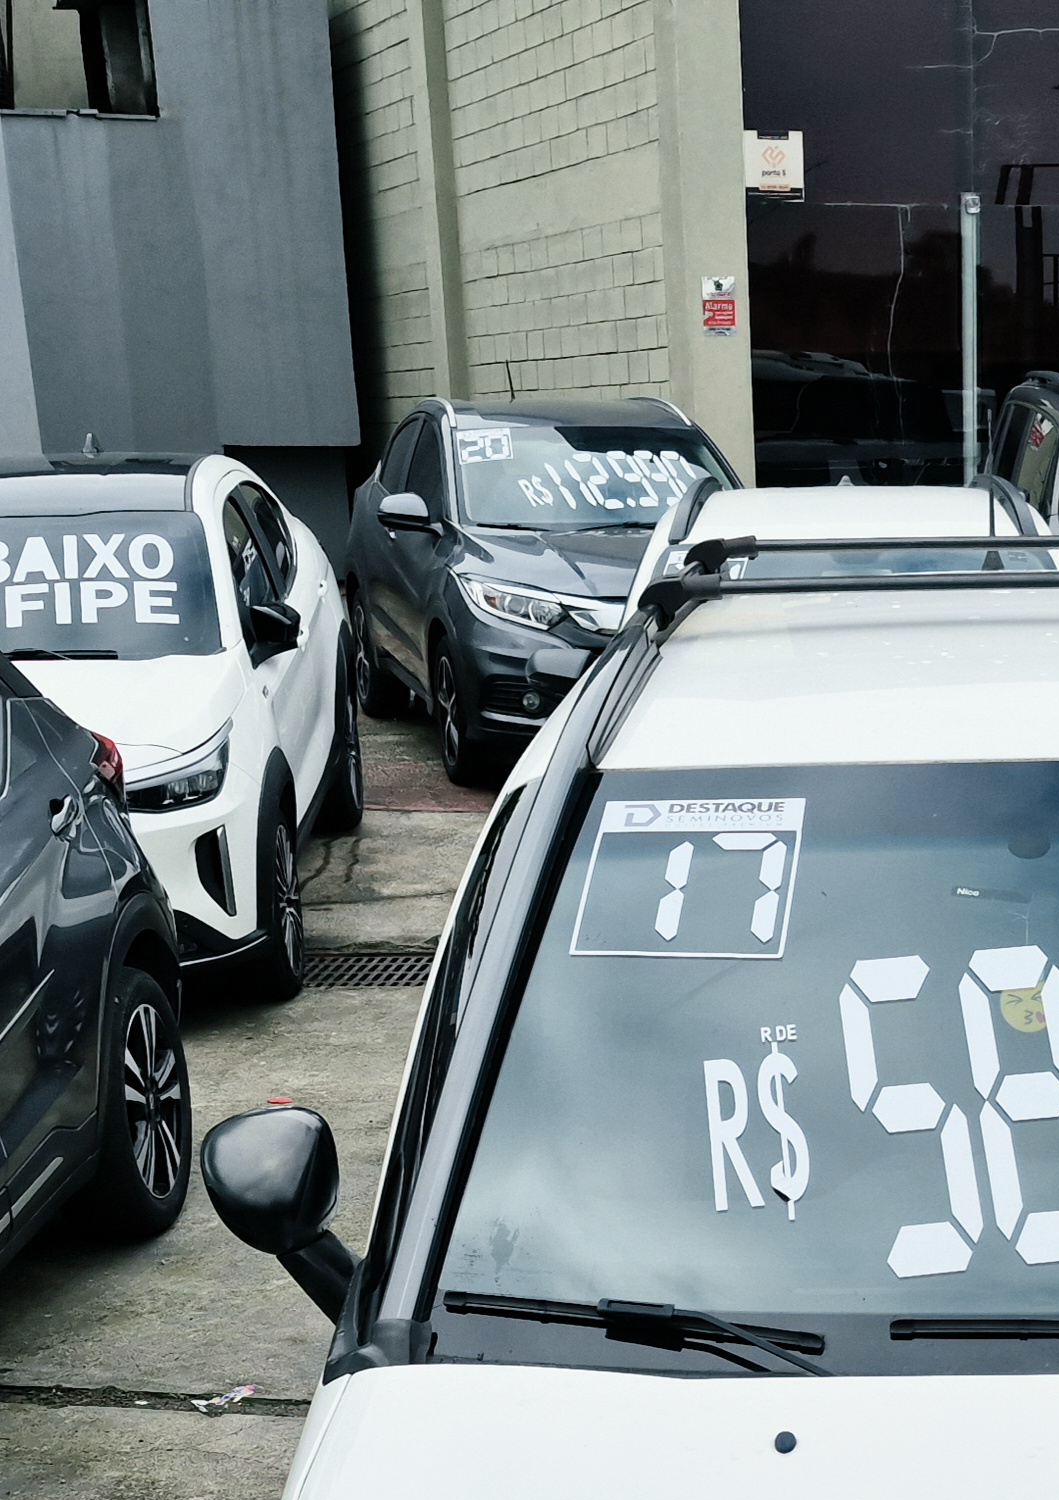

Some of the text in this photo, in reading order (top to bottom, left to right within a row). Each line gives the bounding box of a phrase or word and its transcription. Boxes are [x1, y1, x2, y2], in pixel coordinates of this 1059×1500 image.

[461, 435, 510, 463] 20
[518, 474, 554, 507] R$
[0, 533, 174, 583] AIXO
[4, 580, 180, 628] FIPE
[666, 814, 784, 823] SEMINOVOS
[668, 801, 786, 814] DESTAQUE
[654, 832, 788, 945] 17
[775, 1024, 798, 1041] DE
[703, 1041, 810, 1221] R$
